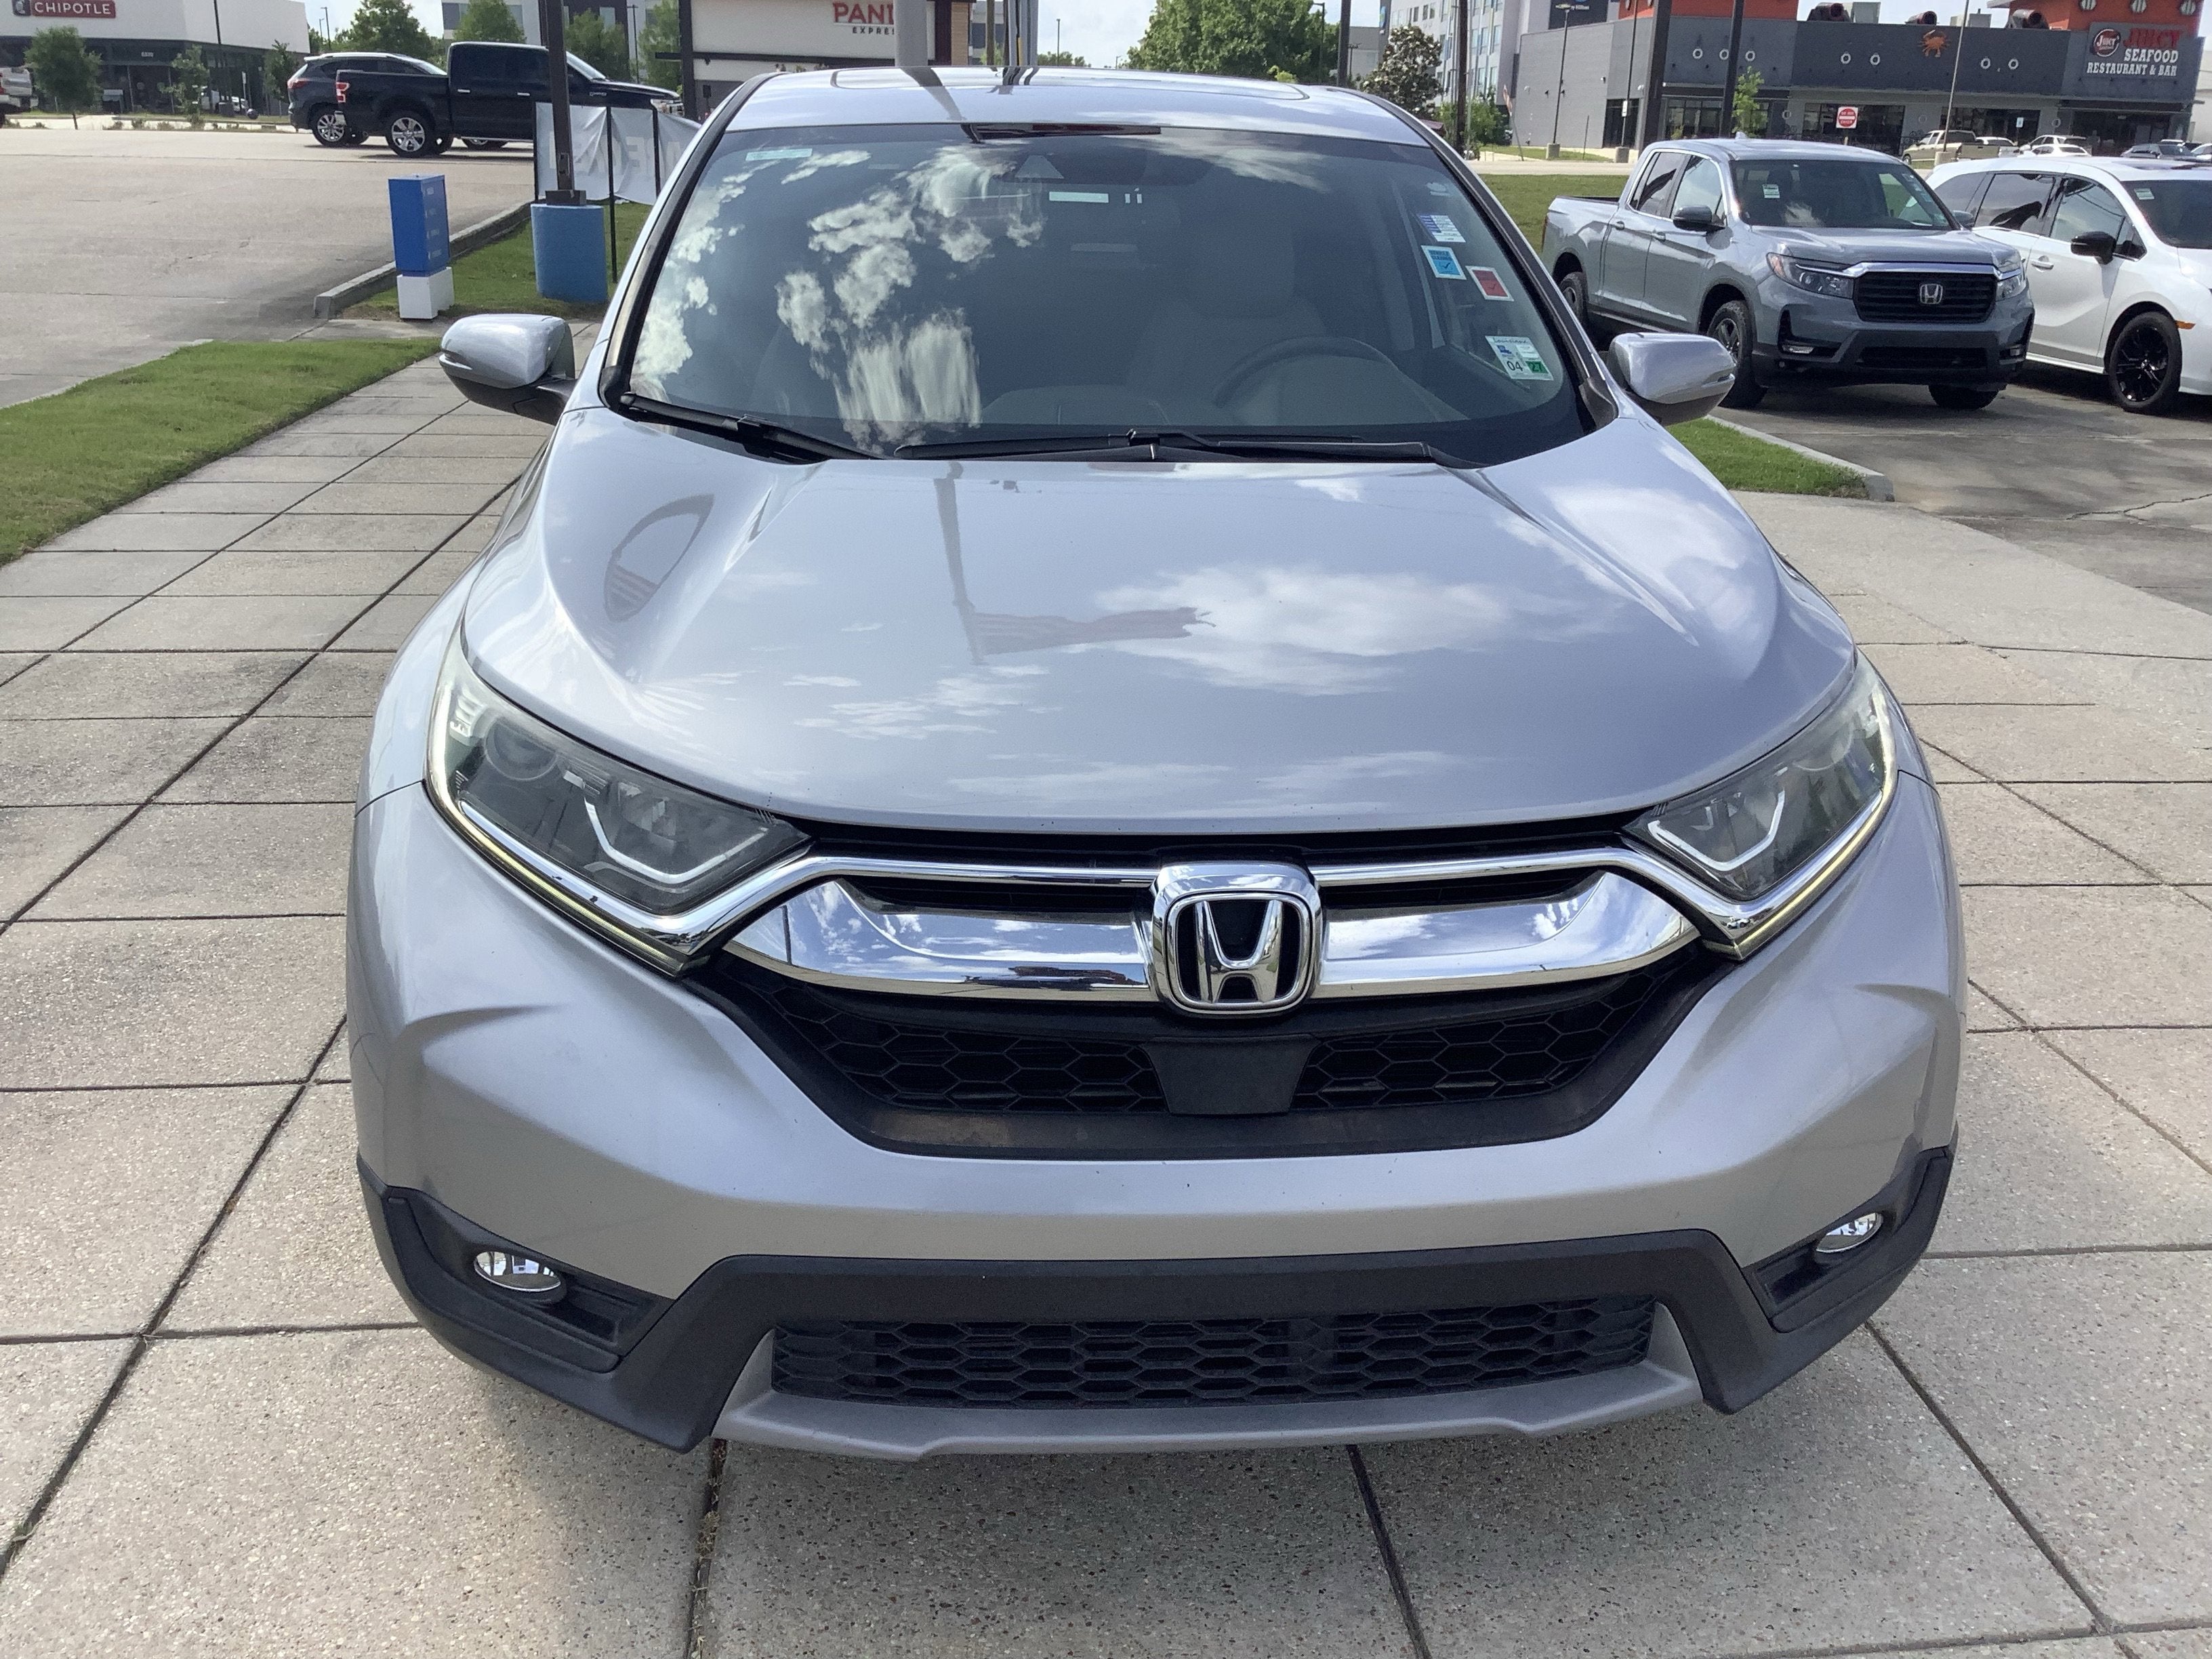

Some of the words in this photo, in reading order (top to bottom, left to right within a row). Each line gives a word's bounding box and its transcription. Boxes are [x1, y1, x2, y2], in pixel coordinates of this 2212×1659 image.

[35, 2, 111, 14] CHIPOTLE
[2124, 49, 2178, 63] SEAFOOD
[2087, 62, 2148, 75] RESTAURANT
[2149, 65, 2156, 75] &
[2158, 64, 2177, 76] BAR
[1507, 361, 1523, 371] 04
[1529, 361, 1544, 372] 27
